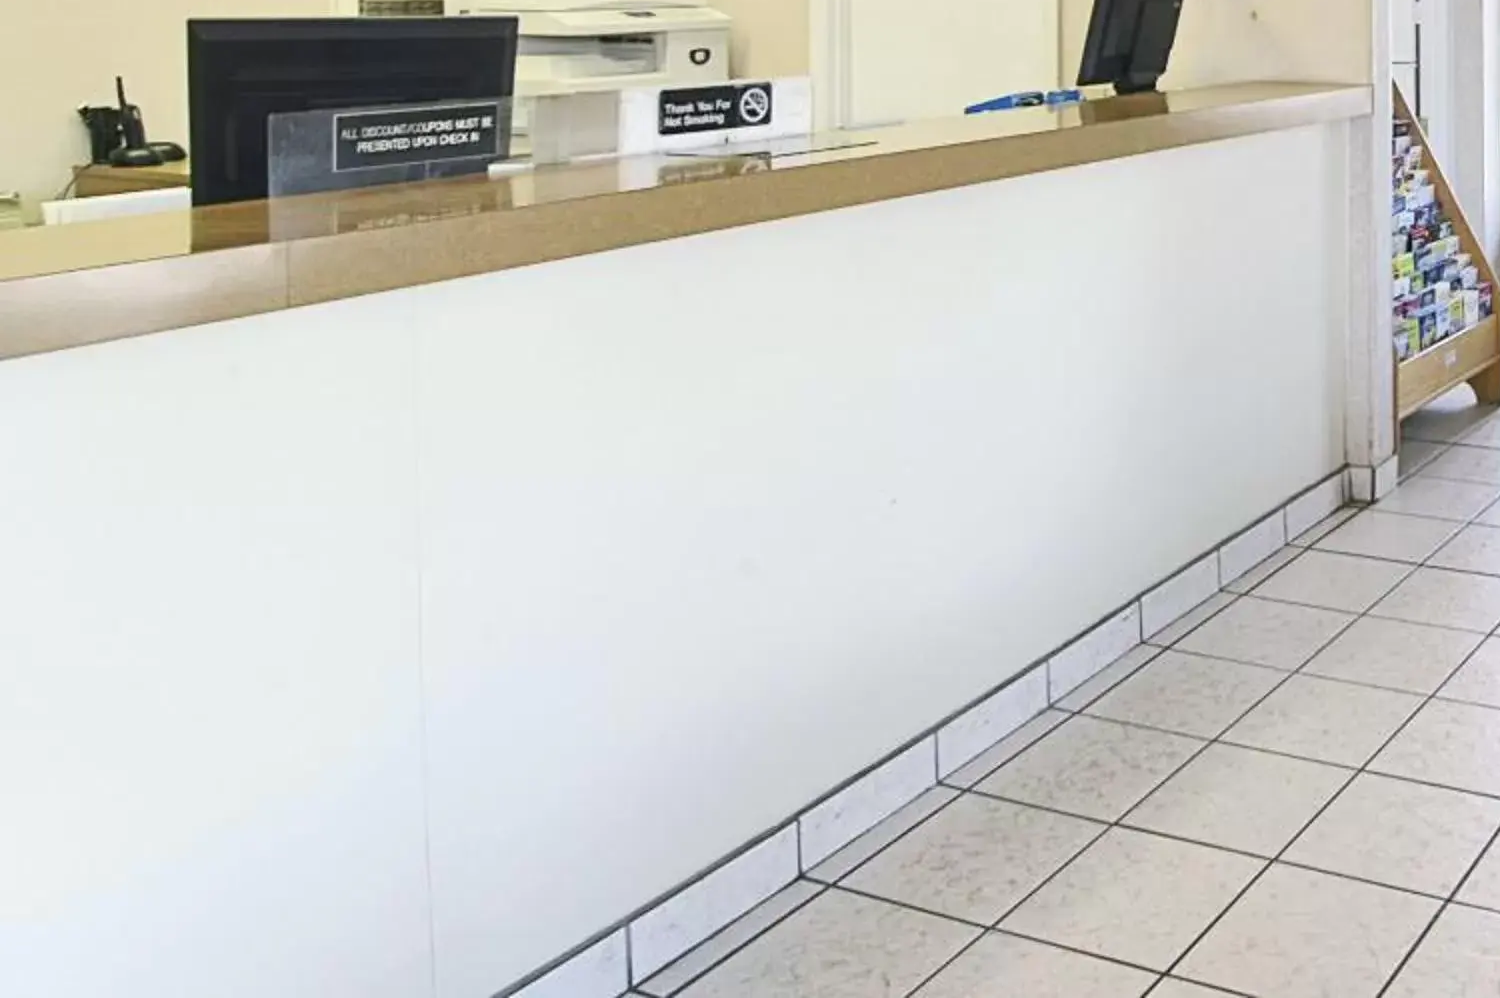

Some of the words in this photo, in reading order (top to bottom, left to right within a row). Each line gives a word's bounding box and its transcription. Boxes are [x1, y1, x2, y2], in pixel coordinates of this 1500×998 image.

[664, 103, 695, 114] Thank
[696, 101, 714, 111] You
[715, 98, 732, 111] For
[340, 128, 359, 140] ALL
[455, 116, 480, 130] MUST
[480, 115, 494, 128] BE
[663, 117, 683, 127] Not
[683, 113, 725, 125] Smoking
[355, 139, 412, 154] PRESENTED
[411, 134, 438, 149] UPON
[438, 131, 469, 146] CHECK
[469, 131, 481, 143] IN
